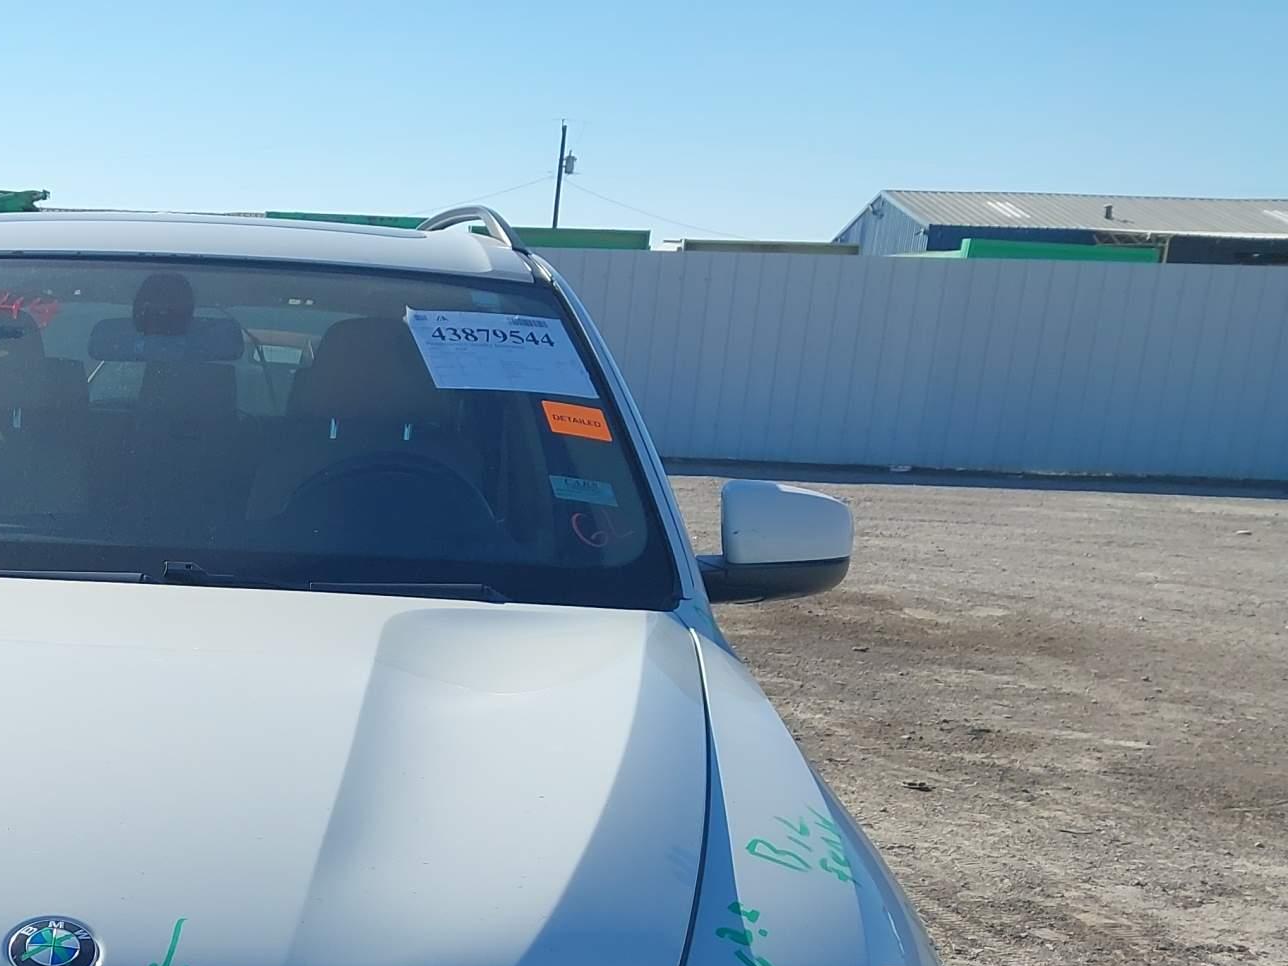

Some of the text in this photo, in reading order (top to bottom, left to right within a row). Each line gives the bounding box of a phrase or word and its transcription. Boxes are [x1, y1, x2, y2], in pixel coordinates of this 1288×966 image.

[431, 326, 555, 347] 43879544
[552, 414, 601, 428] DETAILED
[20, 920, 90, 941] BMW
